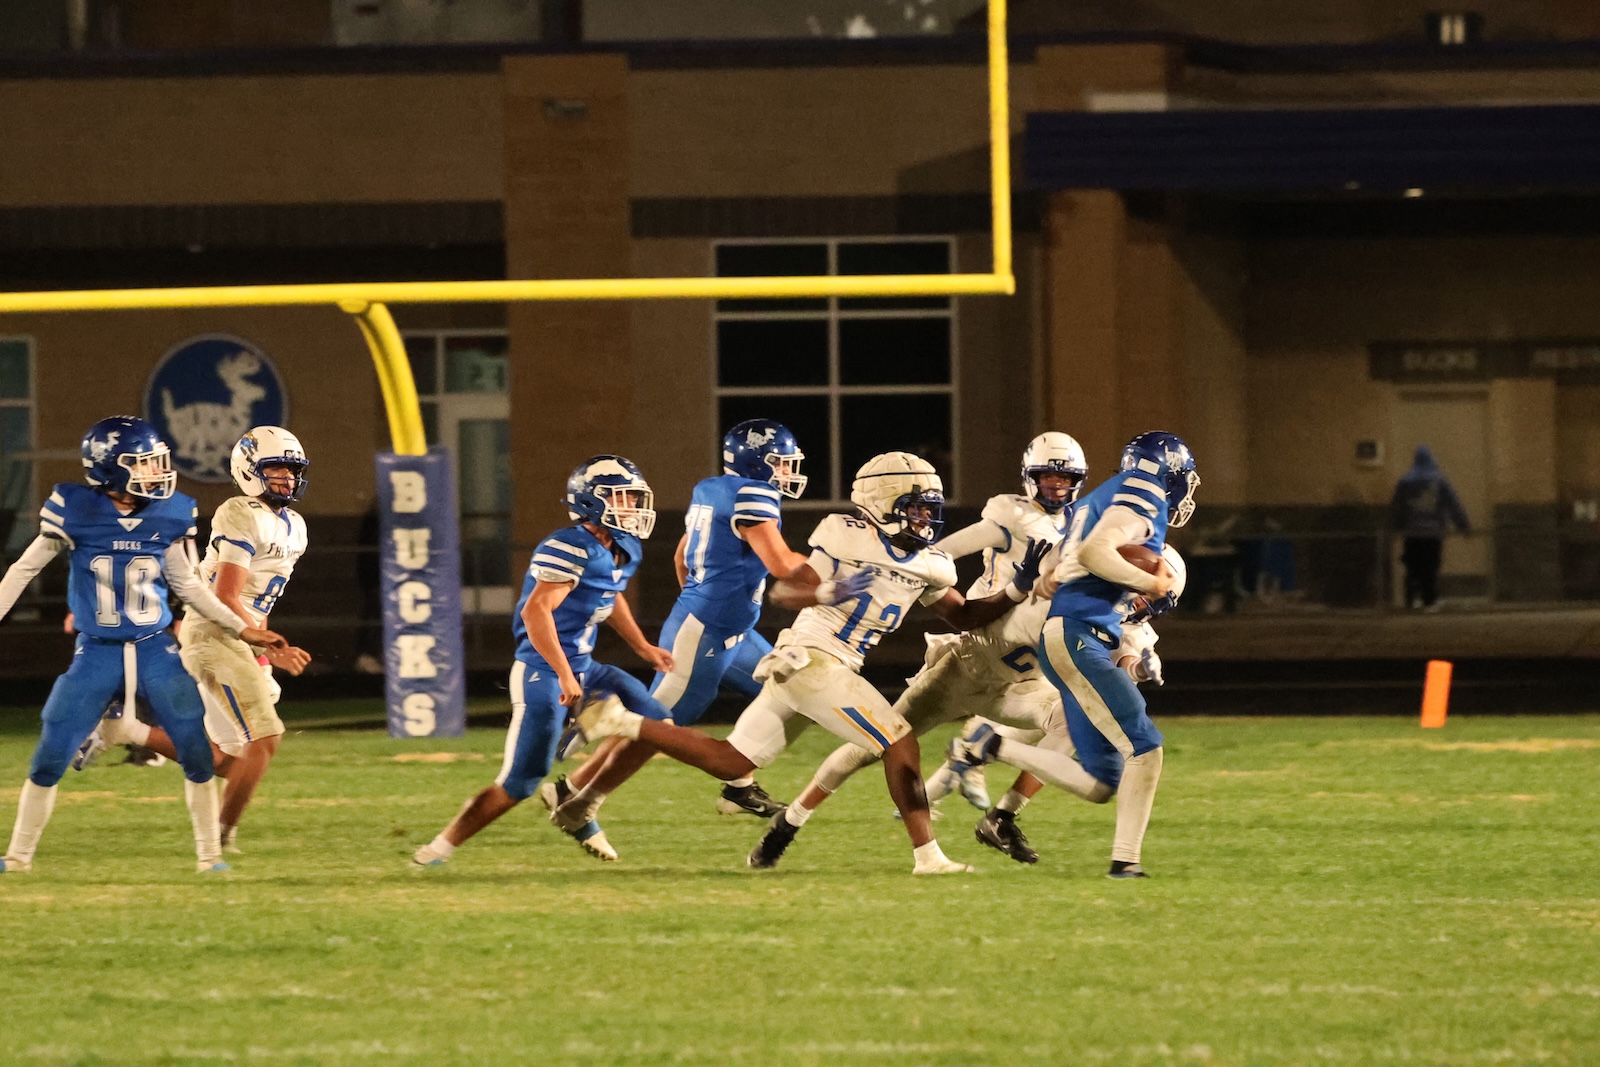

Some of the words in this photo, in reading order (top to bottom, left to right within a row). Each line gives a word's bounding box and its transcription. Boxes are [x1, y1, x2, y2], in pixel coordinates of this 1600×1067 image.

[112, 541, 142, 551] BUCKS
[390, 471, 437, 736] BUCKS
[834, 591, 902, 656] 12
